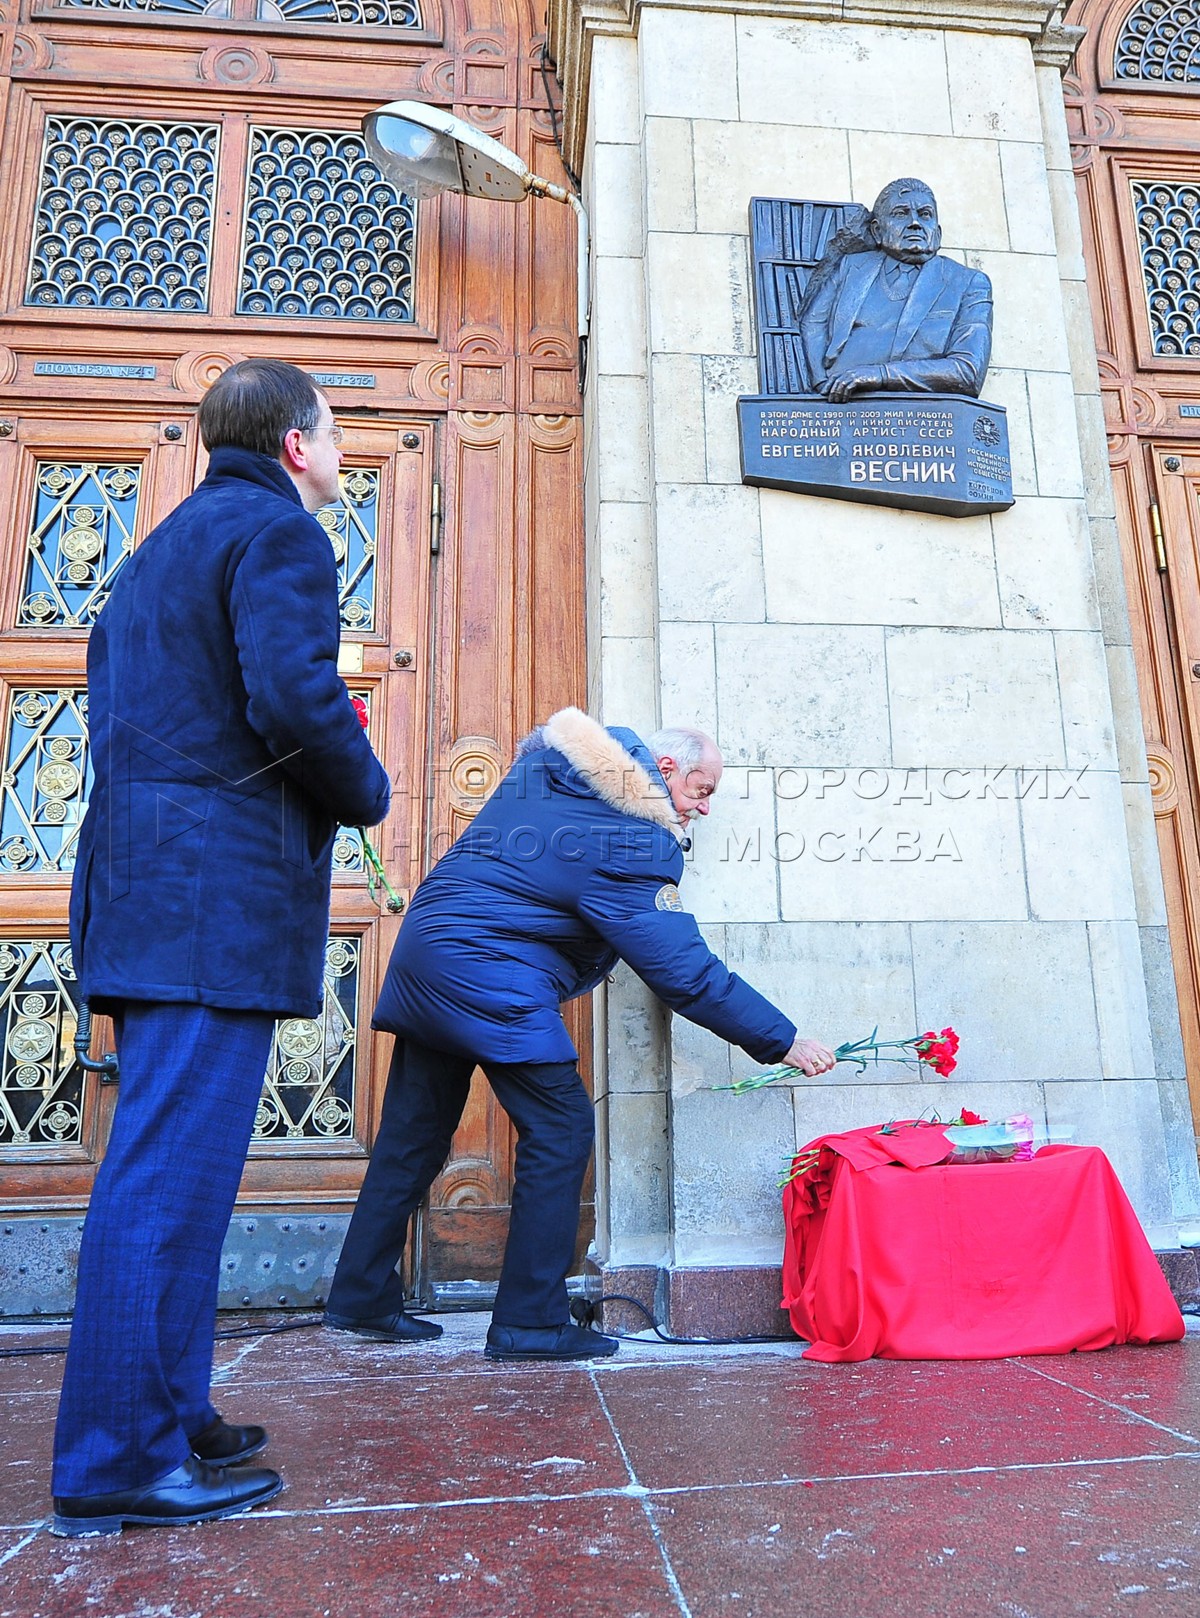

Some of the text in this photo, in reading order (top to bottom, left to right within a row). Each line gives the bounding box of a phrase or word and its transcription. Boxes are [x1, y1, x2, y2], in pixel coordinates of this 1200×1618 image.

[44, 363, 113, 377] ПОДЪЕЗД
[760, 411, 766, 419] В
[767, 411, 788, 419] ЭТОМ
[791, 411, 813, 419] ДОМЕ
[815, 411, 821, 419] С
[823, 411, 844, 419] 1990
[846, 411, 857, 419] ПО
[884, 411, 904, 419] ЖИЛ
[917, 411, 953, 420] РАБОТАЛ
[897, 419, 953, 428] ПИСАТЕЛЬ
[761, 427, 953, 439] НАРОДНЫЙ АРТИСТ СССР
[761, 442, 955, 458] ЕВГЕНИЙ ЯКОВЛЕВИЧ
[850, 460, 956, 482] ВЕСНИК
[973, 468, 1007, 482] ОБЩЕСТВО
